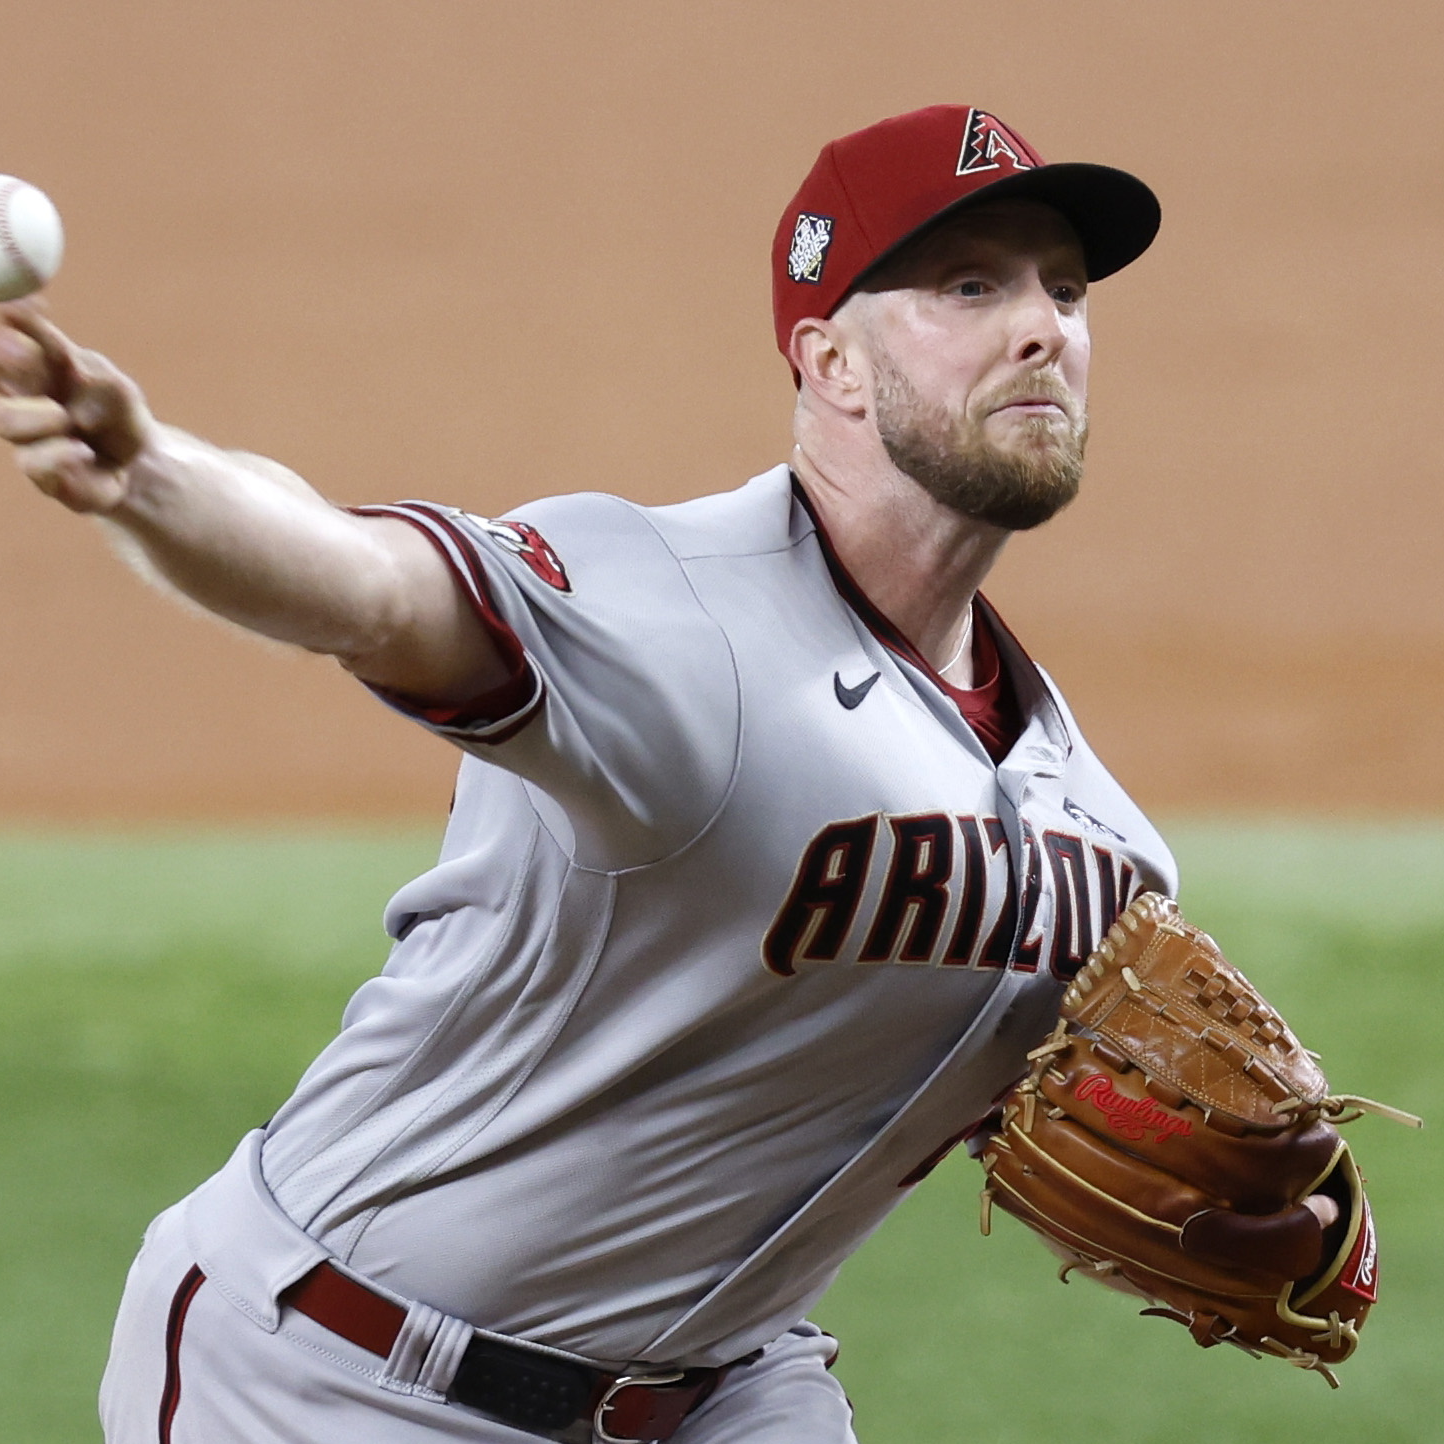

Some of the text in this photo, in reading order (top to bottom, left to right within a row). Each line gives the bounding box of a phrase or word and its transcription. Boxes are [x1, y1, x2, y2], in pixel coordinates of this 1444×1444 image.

[789, 220, 827, 266] WORLD
[793, 234, 830, 281] SERIES
[760, 810, 1147, 981] ARIZON
[1075, 1073, 1193, 1144] Rawlings
